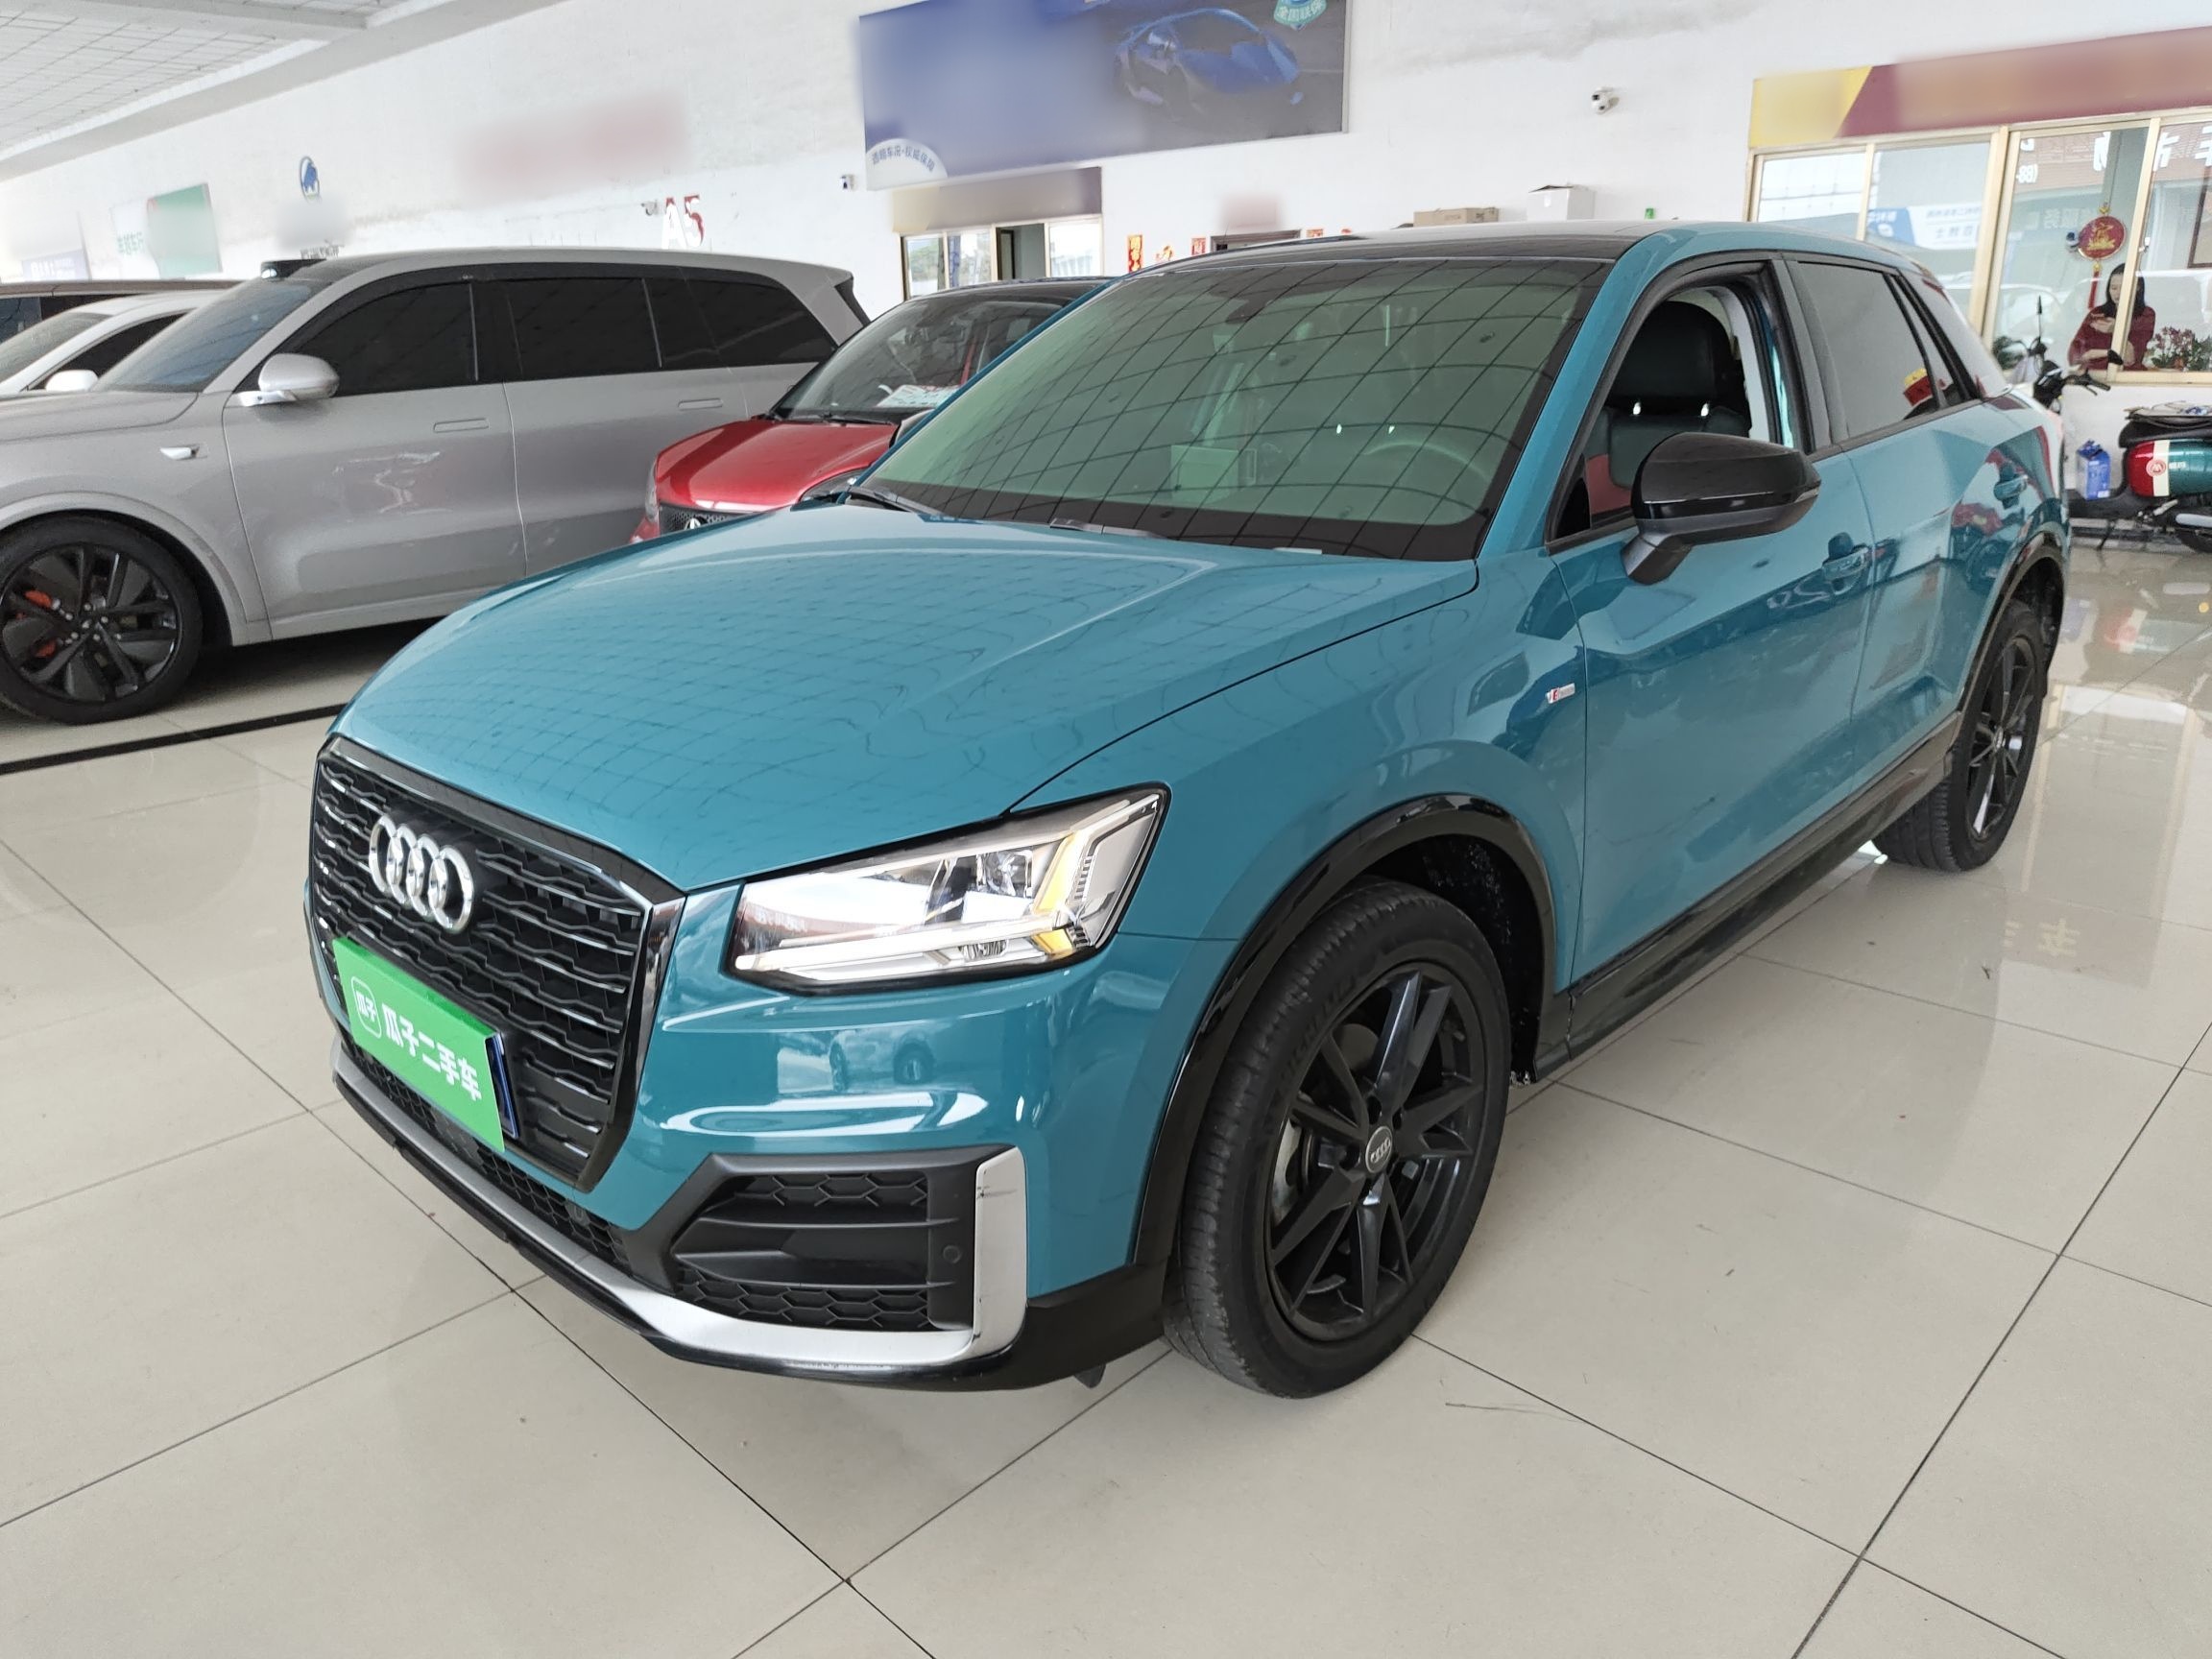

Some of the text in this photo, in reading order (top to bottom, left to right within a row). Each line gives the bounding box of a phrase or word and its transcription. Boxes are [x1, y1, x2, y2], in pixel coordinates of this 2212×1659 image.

[661, 195, 705, 250] A5
[355, 991, 376, 1022] 瓜子
[382, 1003, 482, 1101] 瓜子二手车
